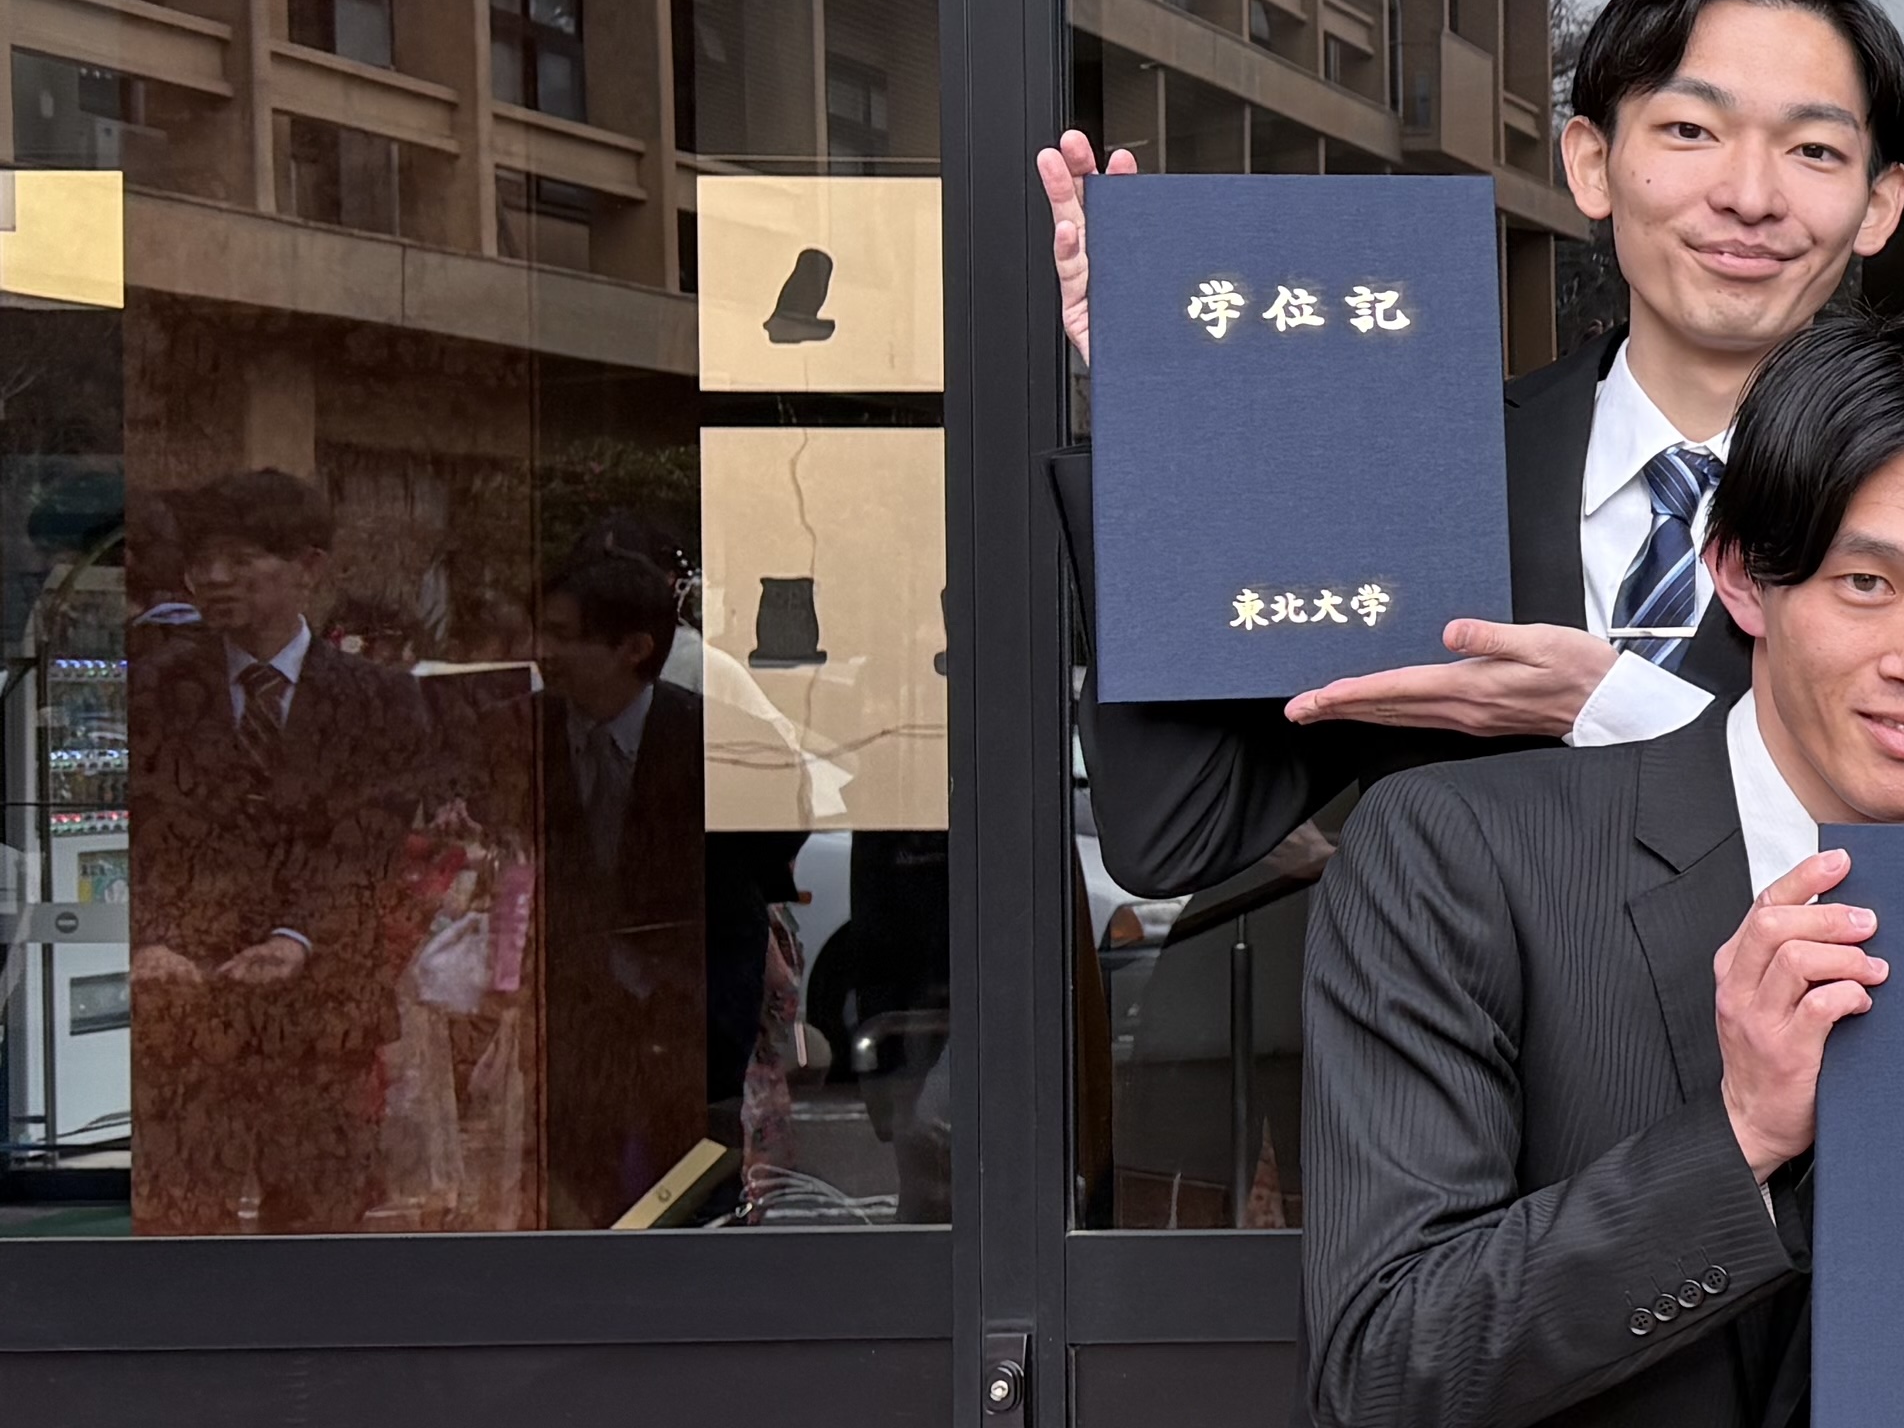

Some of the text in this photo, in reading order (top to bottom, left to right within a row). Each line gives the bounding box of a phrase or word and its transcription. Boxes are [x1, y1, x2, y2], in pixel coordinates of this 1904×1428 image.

[1187, 279, 1411, 339] 学位記
[1229, 583, 1391, 631] 東北大学
